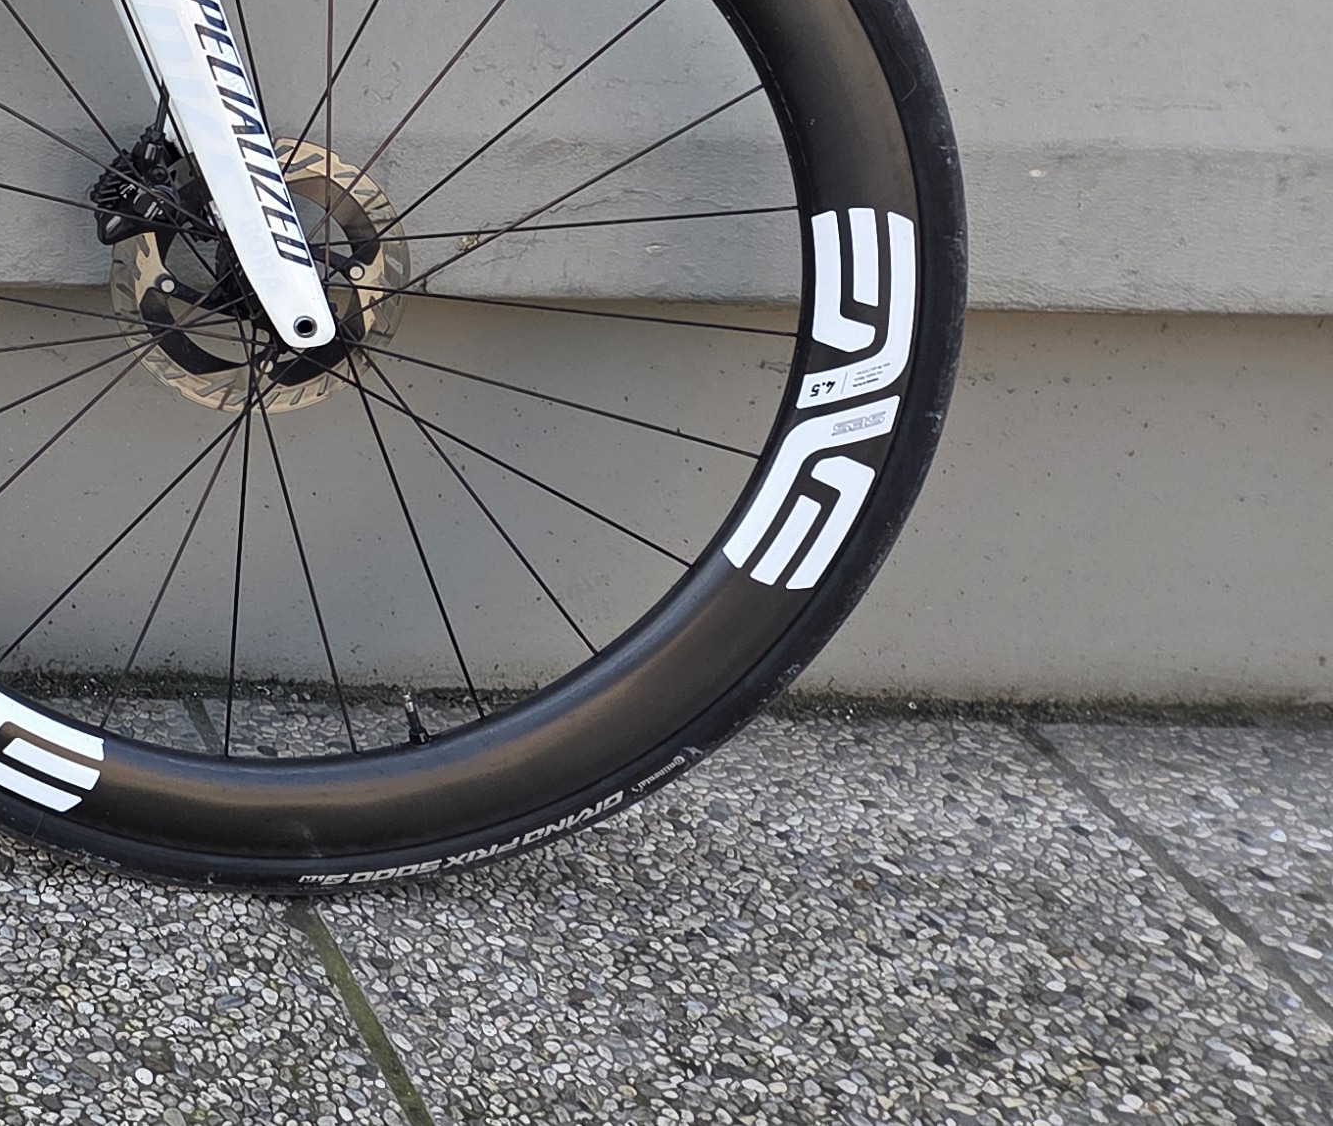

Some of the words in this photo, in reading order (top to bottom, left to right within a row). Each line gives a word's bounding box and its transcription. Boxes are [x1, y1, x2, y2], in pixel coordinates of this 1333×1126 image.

[809, 380, 836, 397] 4.5
[521, 790, 624, 846] GRAND
[442, 836, 520, 869] PRIX
[348, 859, 443, 883] 5000
